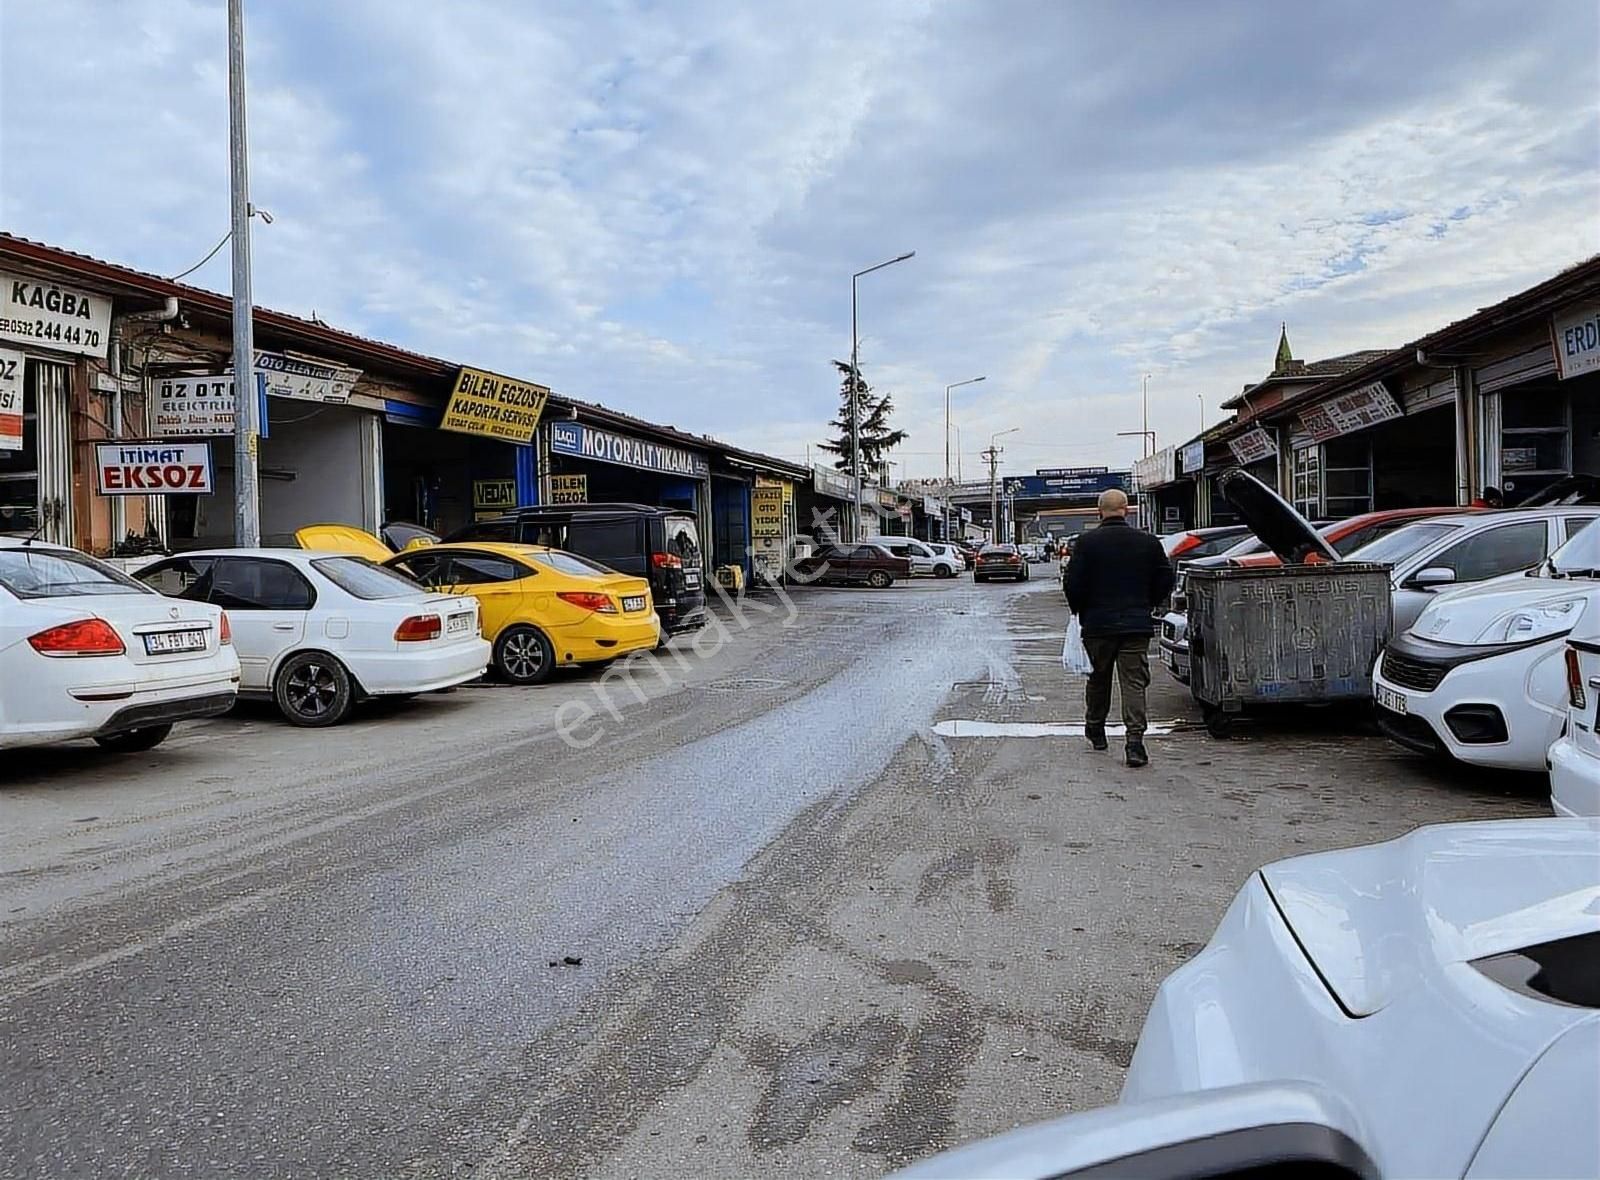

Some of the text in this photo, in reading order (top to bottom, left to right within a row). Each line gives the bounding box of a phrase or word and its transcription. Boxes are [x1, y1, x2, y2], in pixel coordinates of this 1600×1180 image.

[12, 281, 91, 320] KAĞBA
[35, 320, 61, 340] 244
[64, 325, 80, 344] 44
[84, 329, 99, 347] 70
[260, 356, 284, 369] OTO
[161, 381, 187, 398] ÖZ
[498, 383, 545, 409] EGZOST
[452, 398, 501, 420] KAPORTA
[120, 447, 185, 464] İTİMAT
[582, 428, 632, 464] MOTOR
[633, 444, 654, 467] ALT
[655, 446, 694, 474] YIKAMA
[103, 465, 206, 488] EKSOZ
[759, 504, 776, 512] OTO
